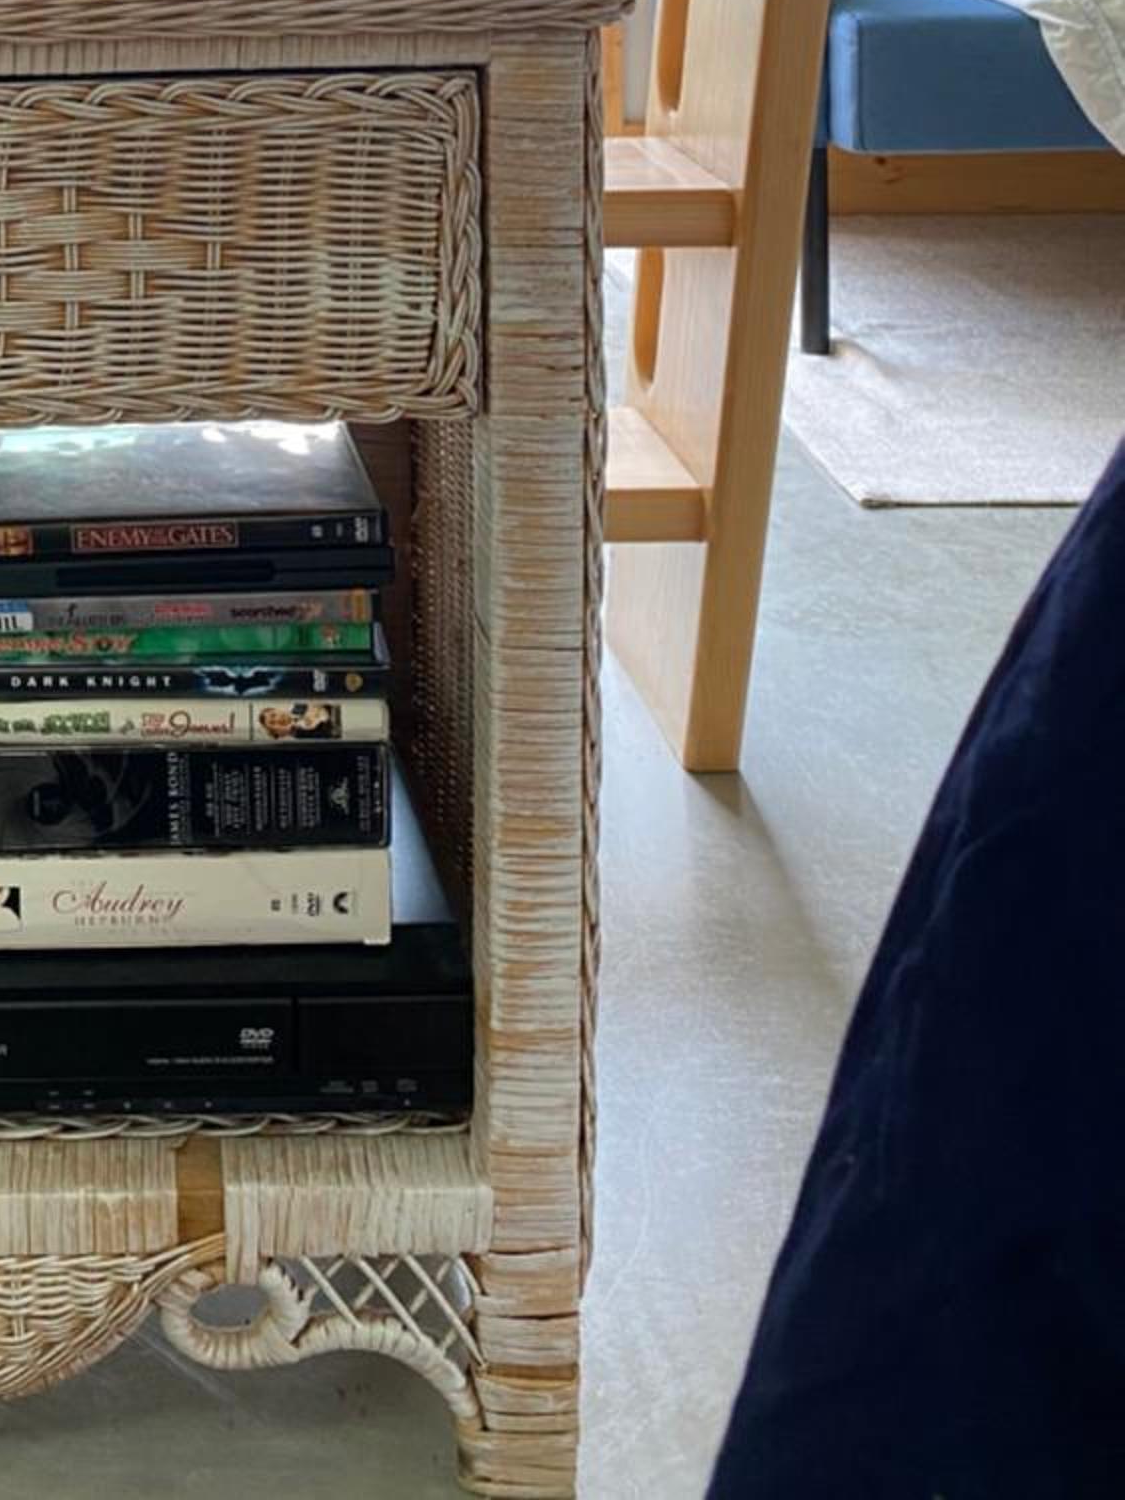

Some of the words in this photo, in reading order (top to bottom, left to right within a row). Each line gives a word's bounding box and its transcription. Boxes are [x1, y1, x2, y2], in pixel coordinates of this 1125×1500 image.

[77, 526, 151, 549] ENEMY
[168, 523, 235, 545] GATES
[11, 676, 70, 688] DARK
[86, 675, 172, 687] KNIGHT
[52, 880, 185, 916] Audrey
[240, 1028, 275, 1039] DVD
